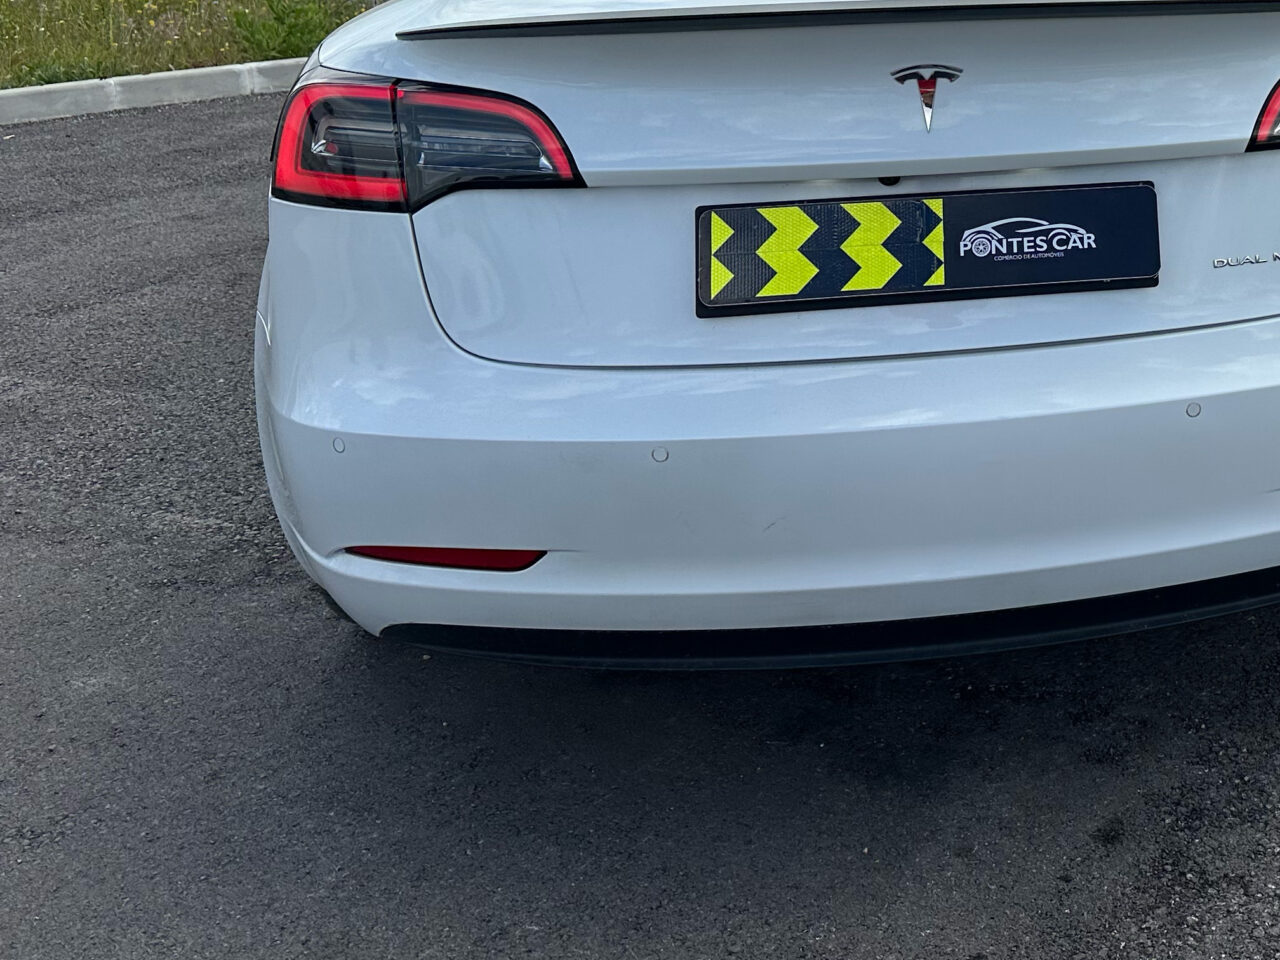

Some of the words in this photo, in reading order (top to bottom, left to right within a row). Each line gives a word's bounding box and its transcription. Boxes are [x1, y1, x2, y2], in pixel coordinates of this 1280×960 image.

[960, 236, 1047, 257] PONTES
[1052, 233, 1096, 251] CAR
[1213, 254, 1267, 268] DUAL
